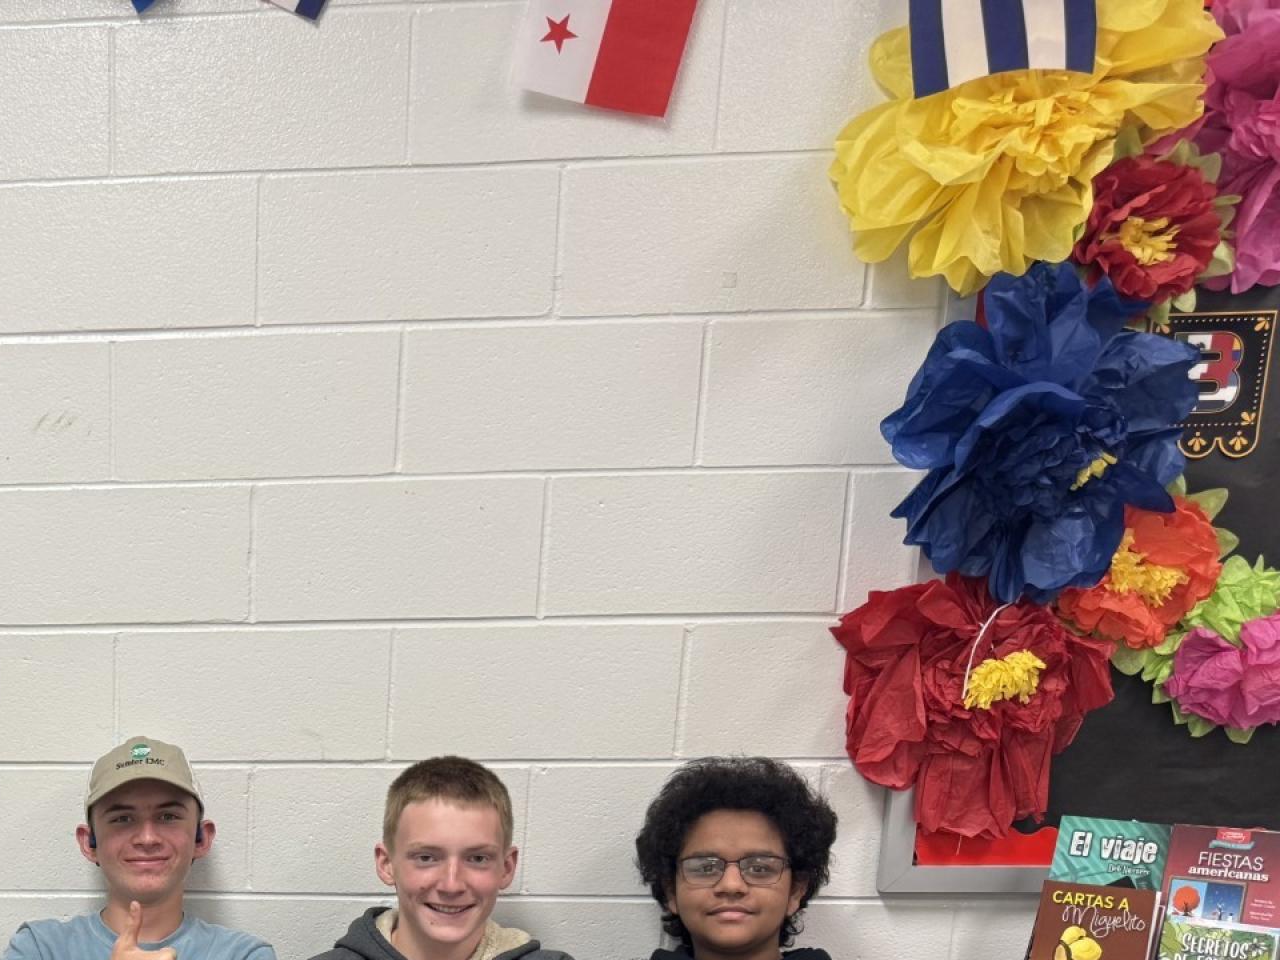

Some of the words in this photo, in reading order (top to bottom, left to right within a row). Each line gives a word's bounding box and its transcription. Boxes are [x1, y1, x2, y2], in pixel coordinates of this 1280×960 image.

[115, 758, 143, 770] Sumter
[146, 758, 165, 766] EMC
[1069, 830, 1094, 858] El
[1100, 835, 1159, 866] viaje
[1198, 851, 1265, 872] FIESTAS
[1187, 866, 1270, 883] americanas
[1051, 889, 1115, 909] CARTAS
[1117, 897, 1130, 913] A
[1061, 904, 1147, 939] Miguelito
[1182, 932, 1250, 960] SECRETOS
